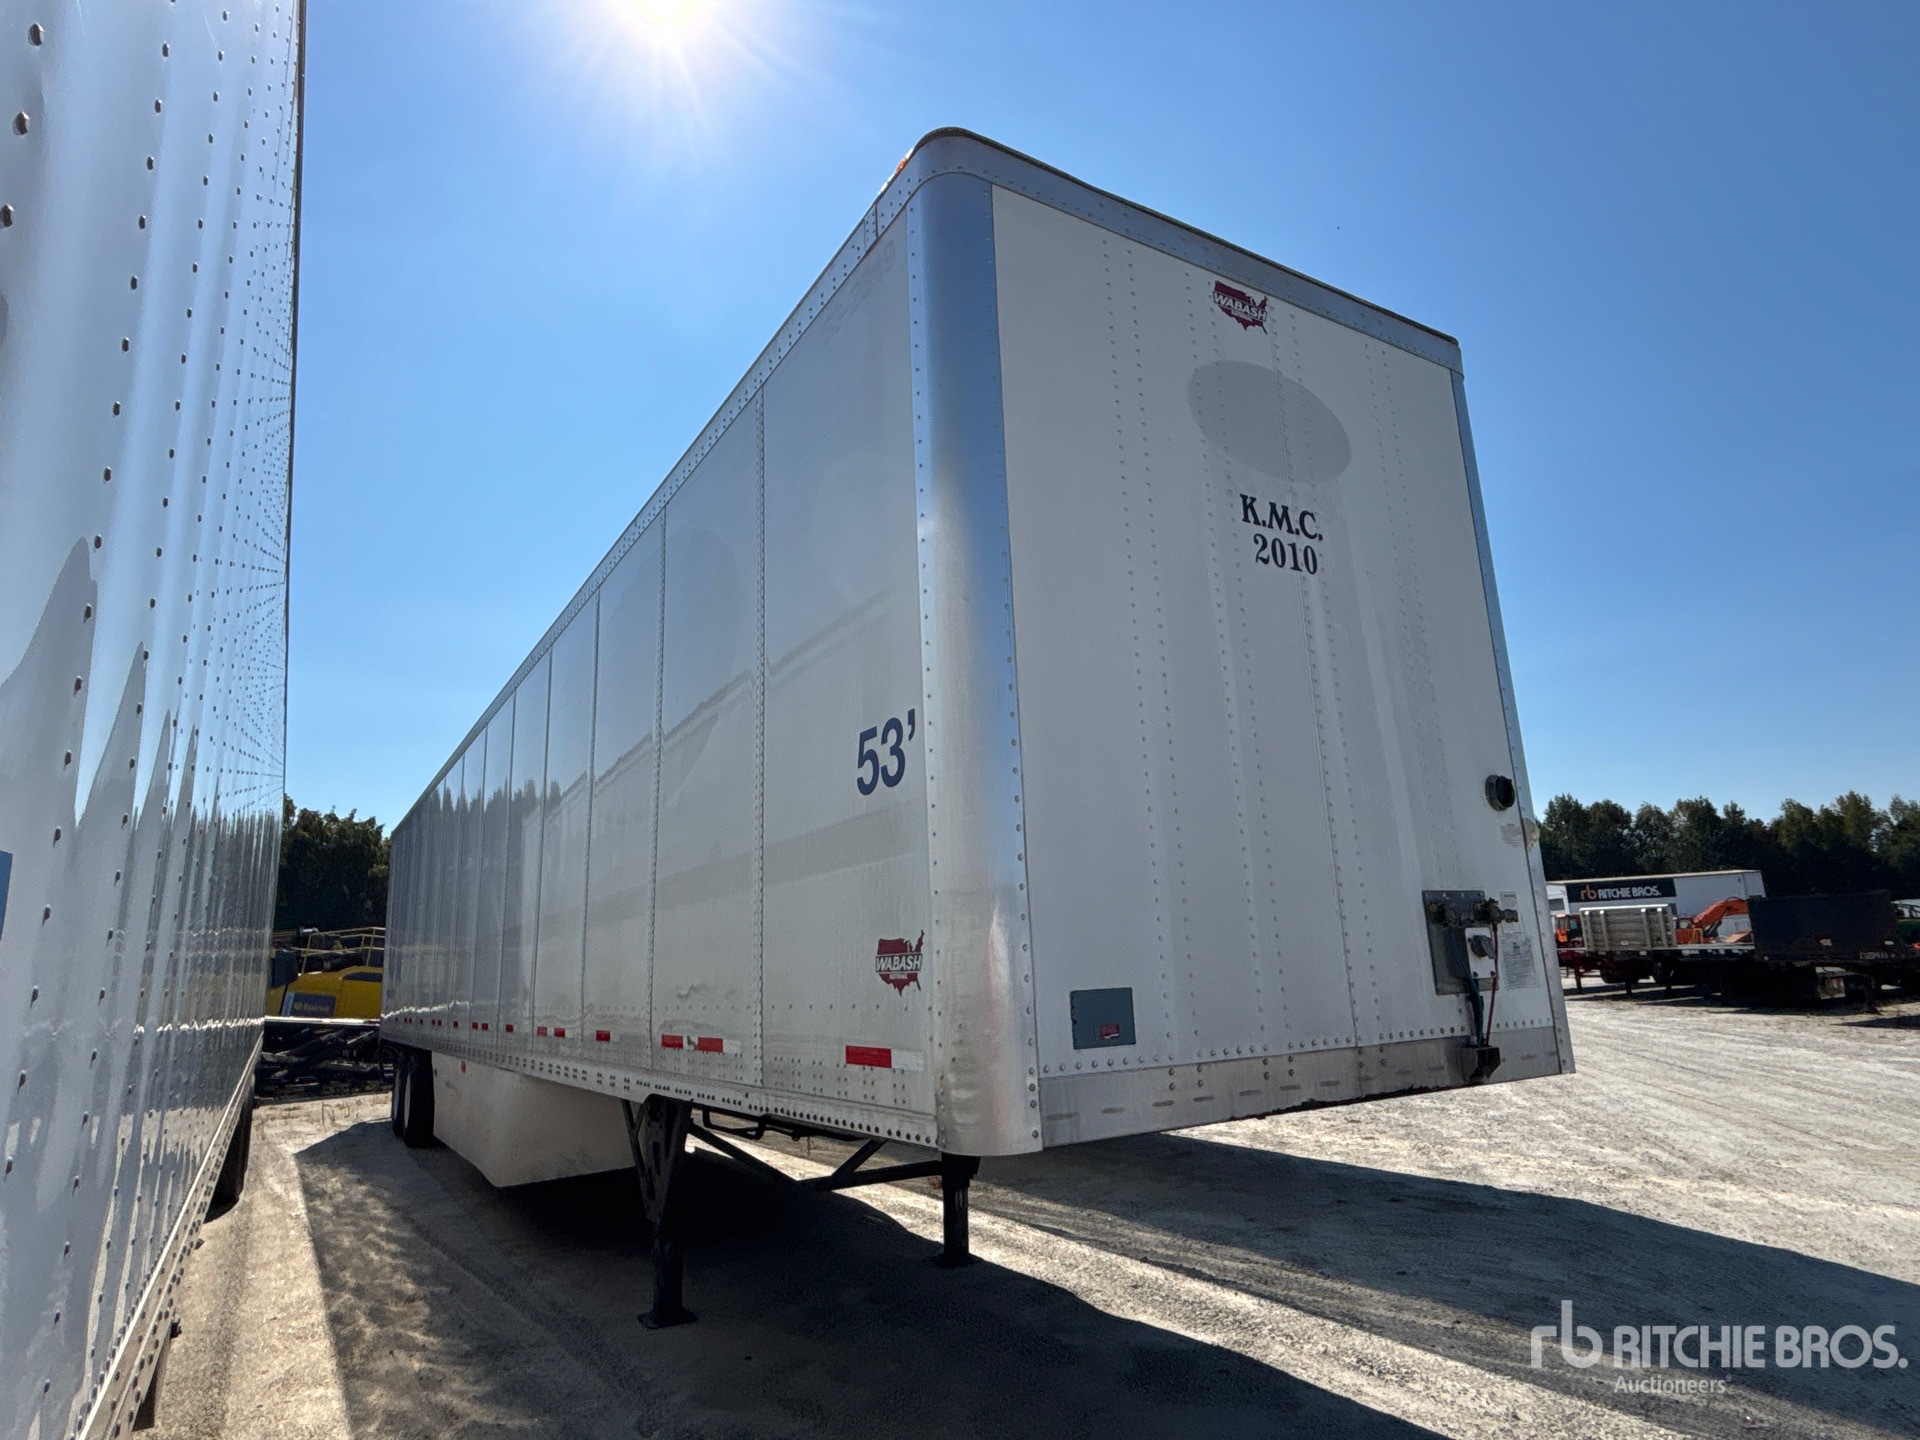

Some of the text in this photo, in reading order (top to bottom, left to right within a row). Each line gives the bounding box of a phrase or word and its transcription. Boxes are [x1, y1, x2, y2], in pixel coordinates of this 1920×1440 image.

[1213, 292, 1267, 322] WABASH
[1239, 493, 1323, 541] K.M.C.
[1253, 533, 1318, 575] 2010
[856, 707, 916, 796] 53'
[1597, 887, 1631, 899] RITCHIE
[1632, 885, 1662, 897] BROS.
[876, 954, 922, 972] WABASH
